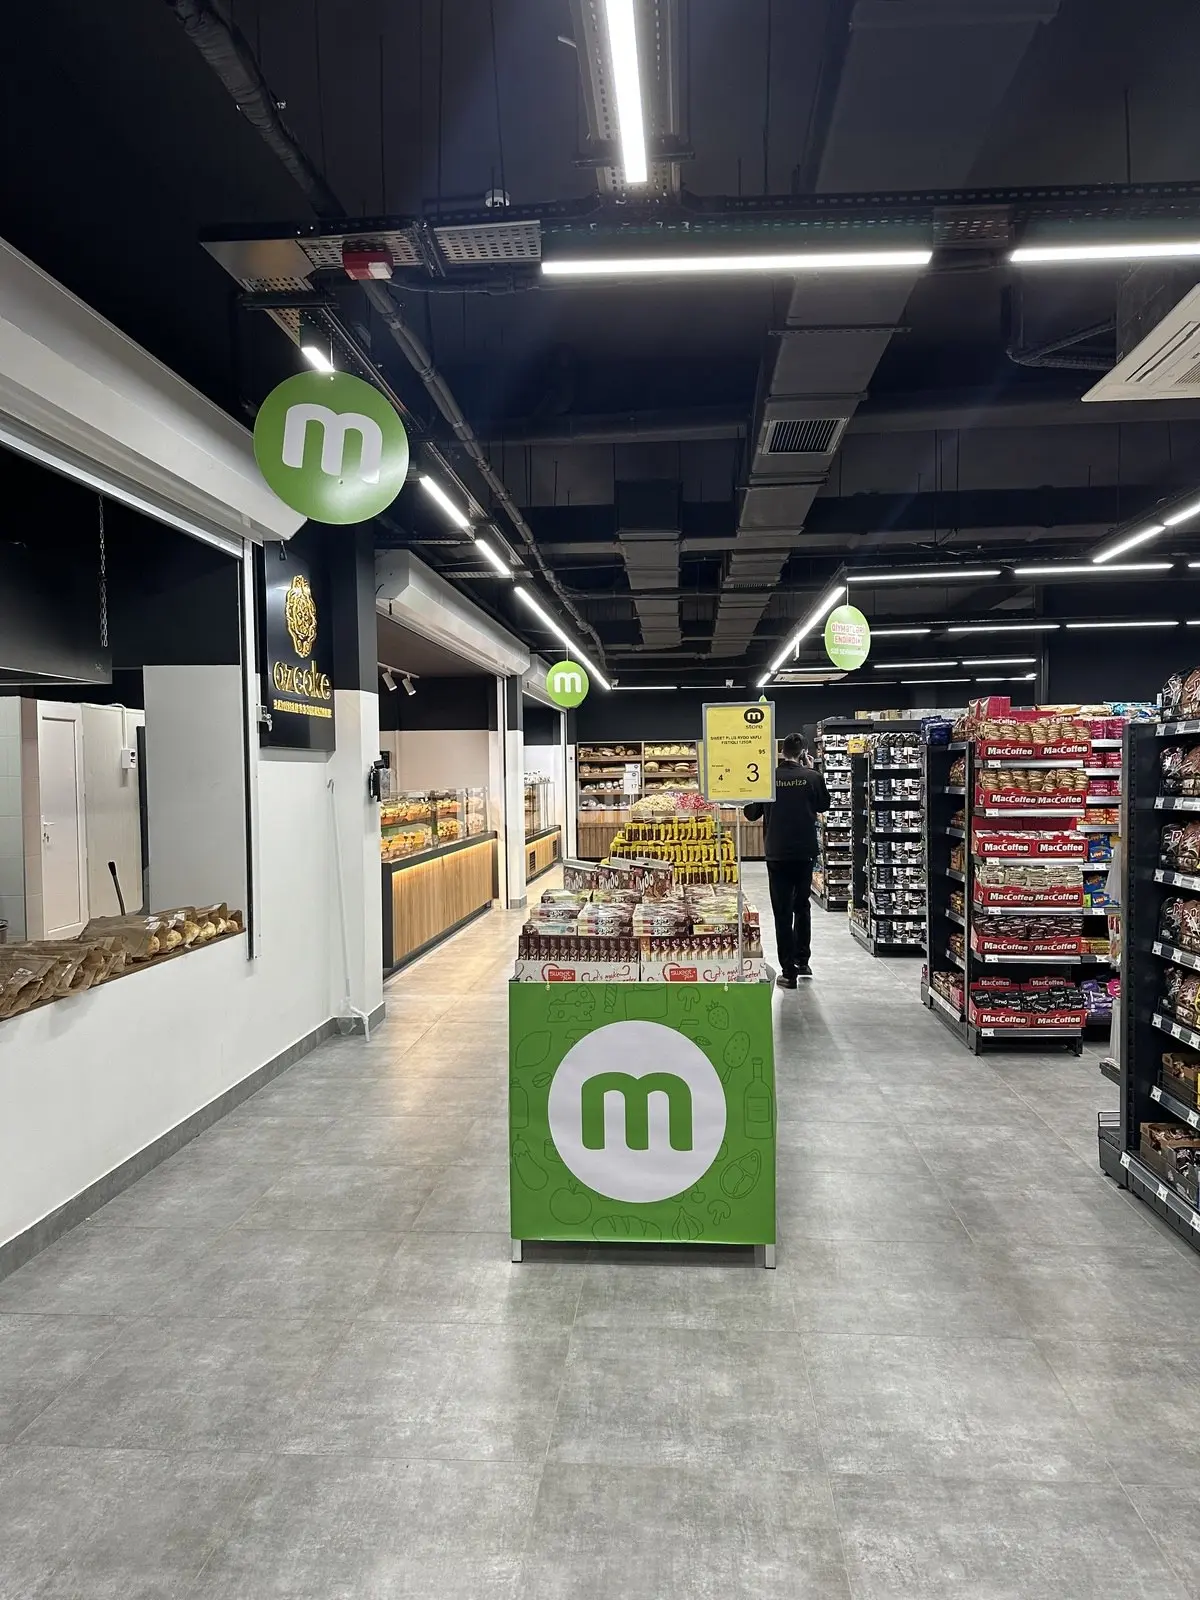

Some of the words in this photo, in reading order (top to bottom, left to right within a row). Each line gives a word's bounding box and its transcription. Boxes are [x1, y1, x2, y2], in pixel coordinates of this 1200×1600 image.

[282, 403, 383, 484] m
[554, 671, 582, 693] m
[747, 712, 761, 720] m
[987, 746, 1033, 755] MacCoffee
[1043, 744, 1088, 754] MacCoffee
[746, 763, 760, 783] 3
[991, 794, 1036, 804] MacCoffee
[1037, 794, 1082, 803] MacCoffee
[984, 842, 1029, 851] MacCoffee
[1039, 842, 1084, 851] MacCoffee
[989, 892, 1034, 901] MacCoffee
[1035, 892, 1079, 900] MacCoffee
[984, 942, 1029, 951] MacCoffee
[1034, 942, 1077, 951] MacCoffee
[982, 1014, 1027, 1023] MacCoffee
[1037, 1014, 1081, 1024] MacCoffee
[581, 1071, 694, 1152] m
